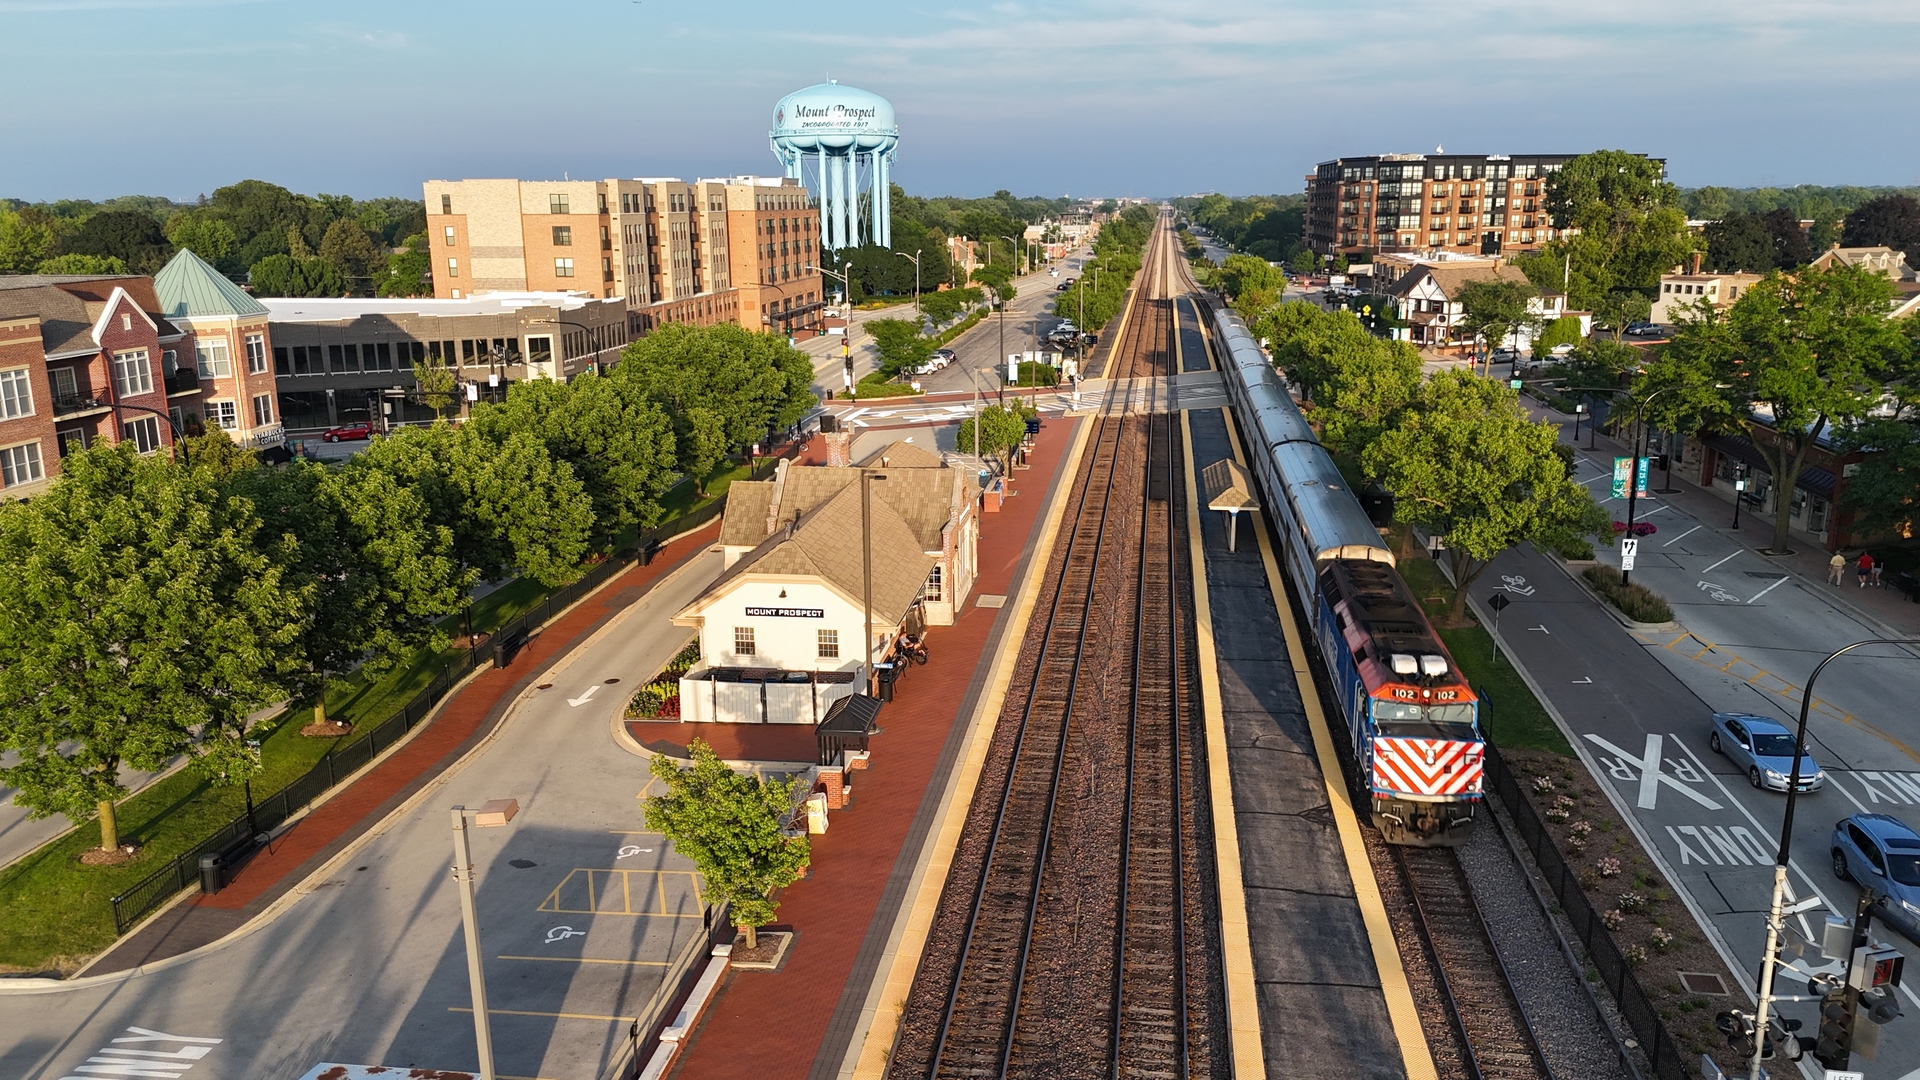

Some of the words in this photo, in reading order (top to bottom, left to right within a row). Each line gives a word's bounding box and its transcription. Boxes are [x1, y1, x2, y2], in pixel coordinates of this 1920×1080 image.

[795, 104, 831, 118] Mount
[833, 104, 876, 121] Prospect
[254, 427, 285, 440] STARBUCKS
[260, 434, 280, 445] COFFEE
[747, 608, 777, 616] MOUNT
[778, 609, 823, 617] PROSPECT
[1395, 689, 1414, 699] 102
[1437, 691, 1455, 700] 102
[1665, 825, 1776, 866] ONLY
[57, 1026, 224, 1080] NLY
